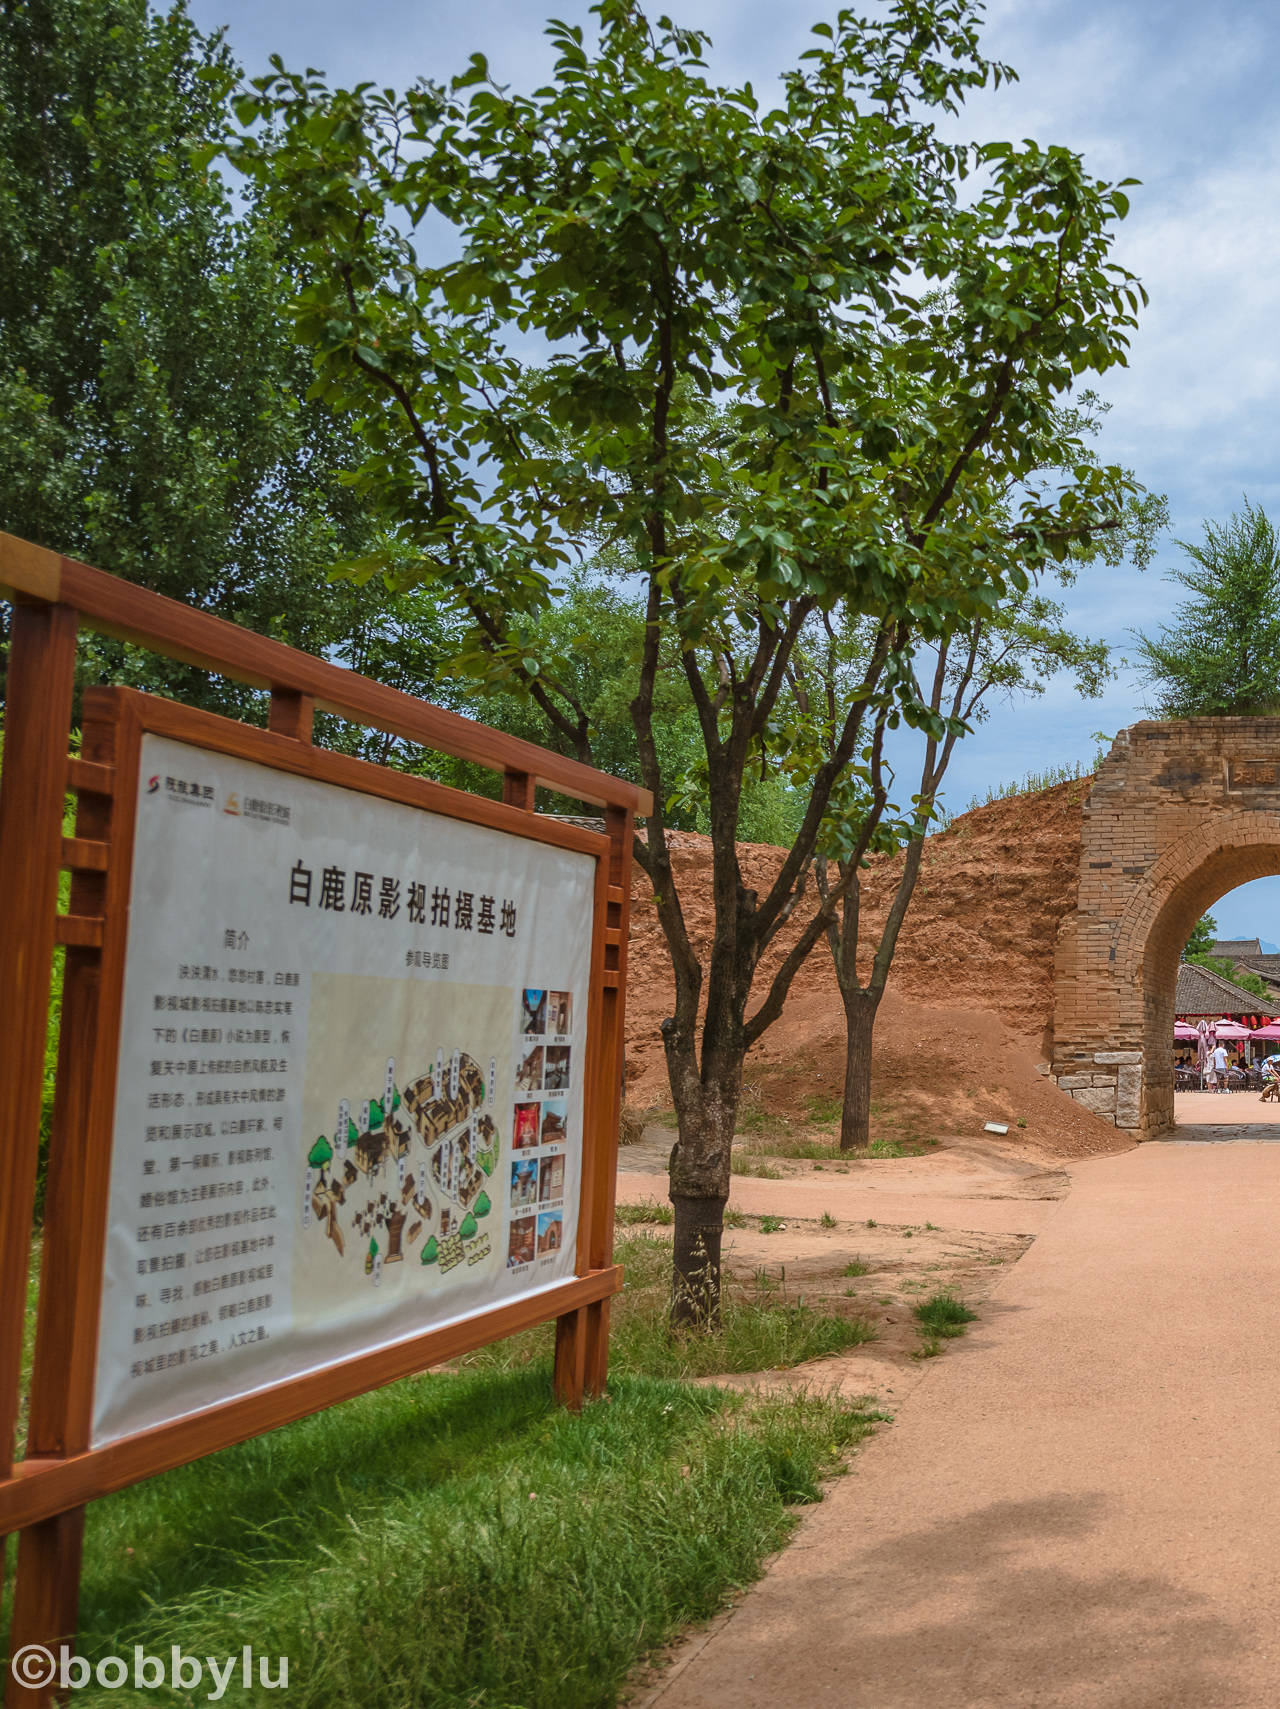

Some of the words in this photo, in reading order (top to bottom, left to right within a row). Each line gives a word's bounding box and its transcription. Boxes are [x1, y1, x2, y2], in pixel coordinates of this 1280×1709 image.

[290, 859, 516, 937] 白鹿原影视拍摄基地
[225, 928, 249, 950] 简介
